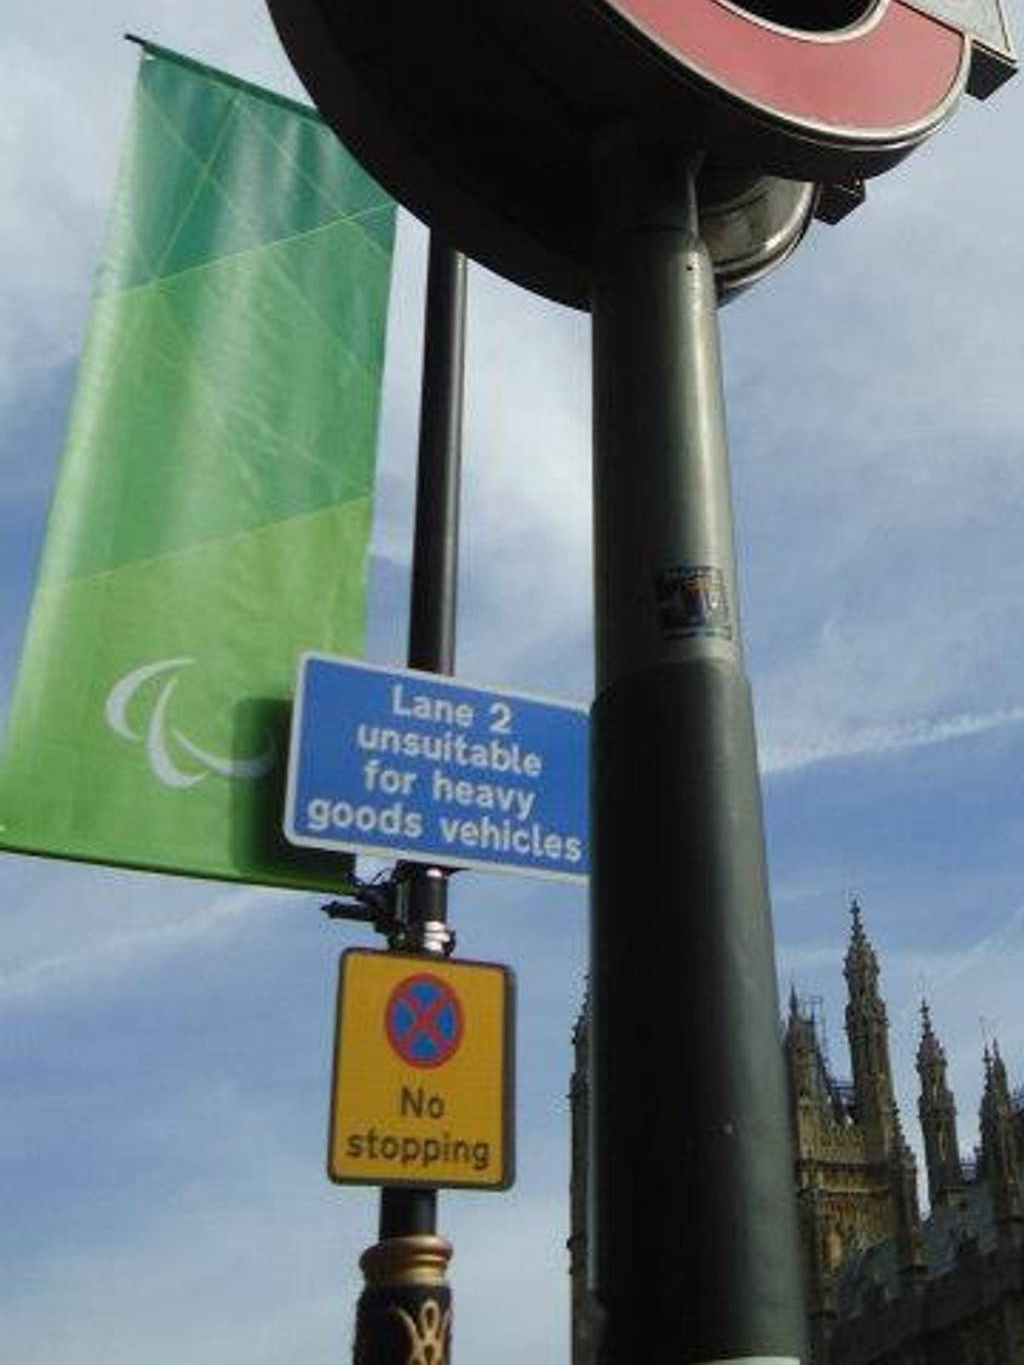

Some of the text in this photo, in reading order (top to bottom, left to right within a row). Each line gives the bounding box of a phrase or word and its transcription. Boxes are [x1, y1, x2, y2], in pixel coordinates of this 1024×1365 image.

[391, 683, 512, 734] Lane 2
[356, 723, 542, 778] unsuitable
[364, 759, 536, 820] for heavy
[307, 797, 582, 863] goods vehicles
[400, 1085, 446, 1120] No
[346, 1129, 491, 1170] stopping
